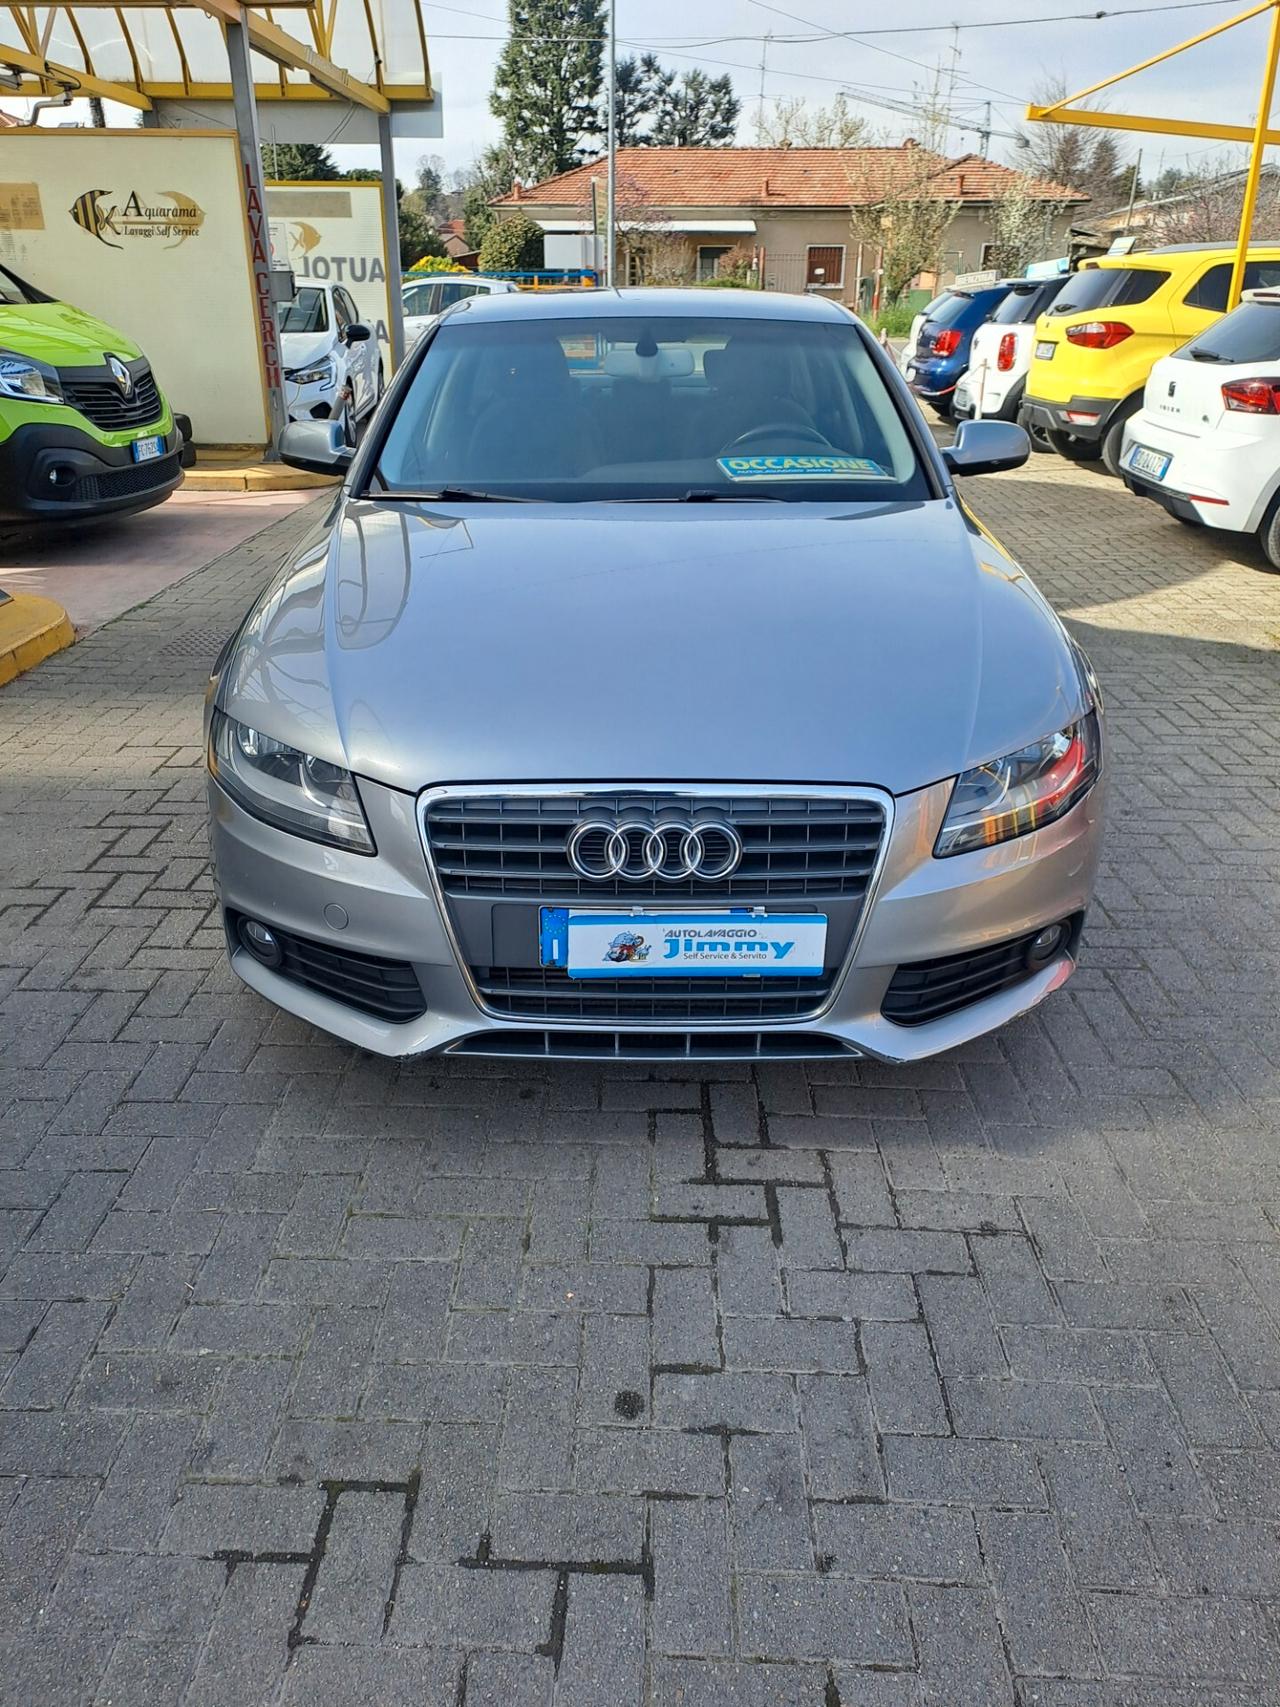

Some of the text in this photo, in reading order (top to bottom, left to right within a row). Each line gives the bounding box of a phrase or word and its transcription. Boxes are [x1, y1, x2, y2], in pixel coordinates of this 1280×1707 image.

[245, 164, 267, 263] LAVA
[124, 225, 200, 238] Lavaggi Self Service
[728, 457, 875, 470] OCCASIONE
[664, 929, 758, 938] AUTOLAVAGGIO
[663, 939, 795, 959] Jimmy
[683, 952, 698, 960] Self
[730, 952, 737, 960] &
[739, 952, 767, 960] Servito
